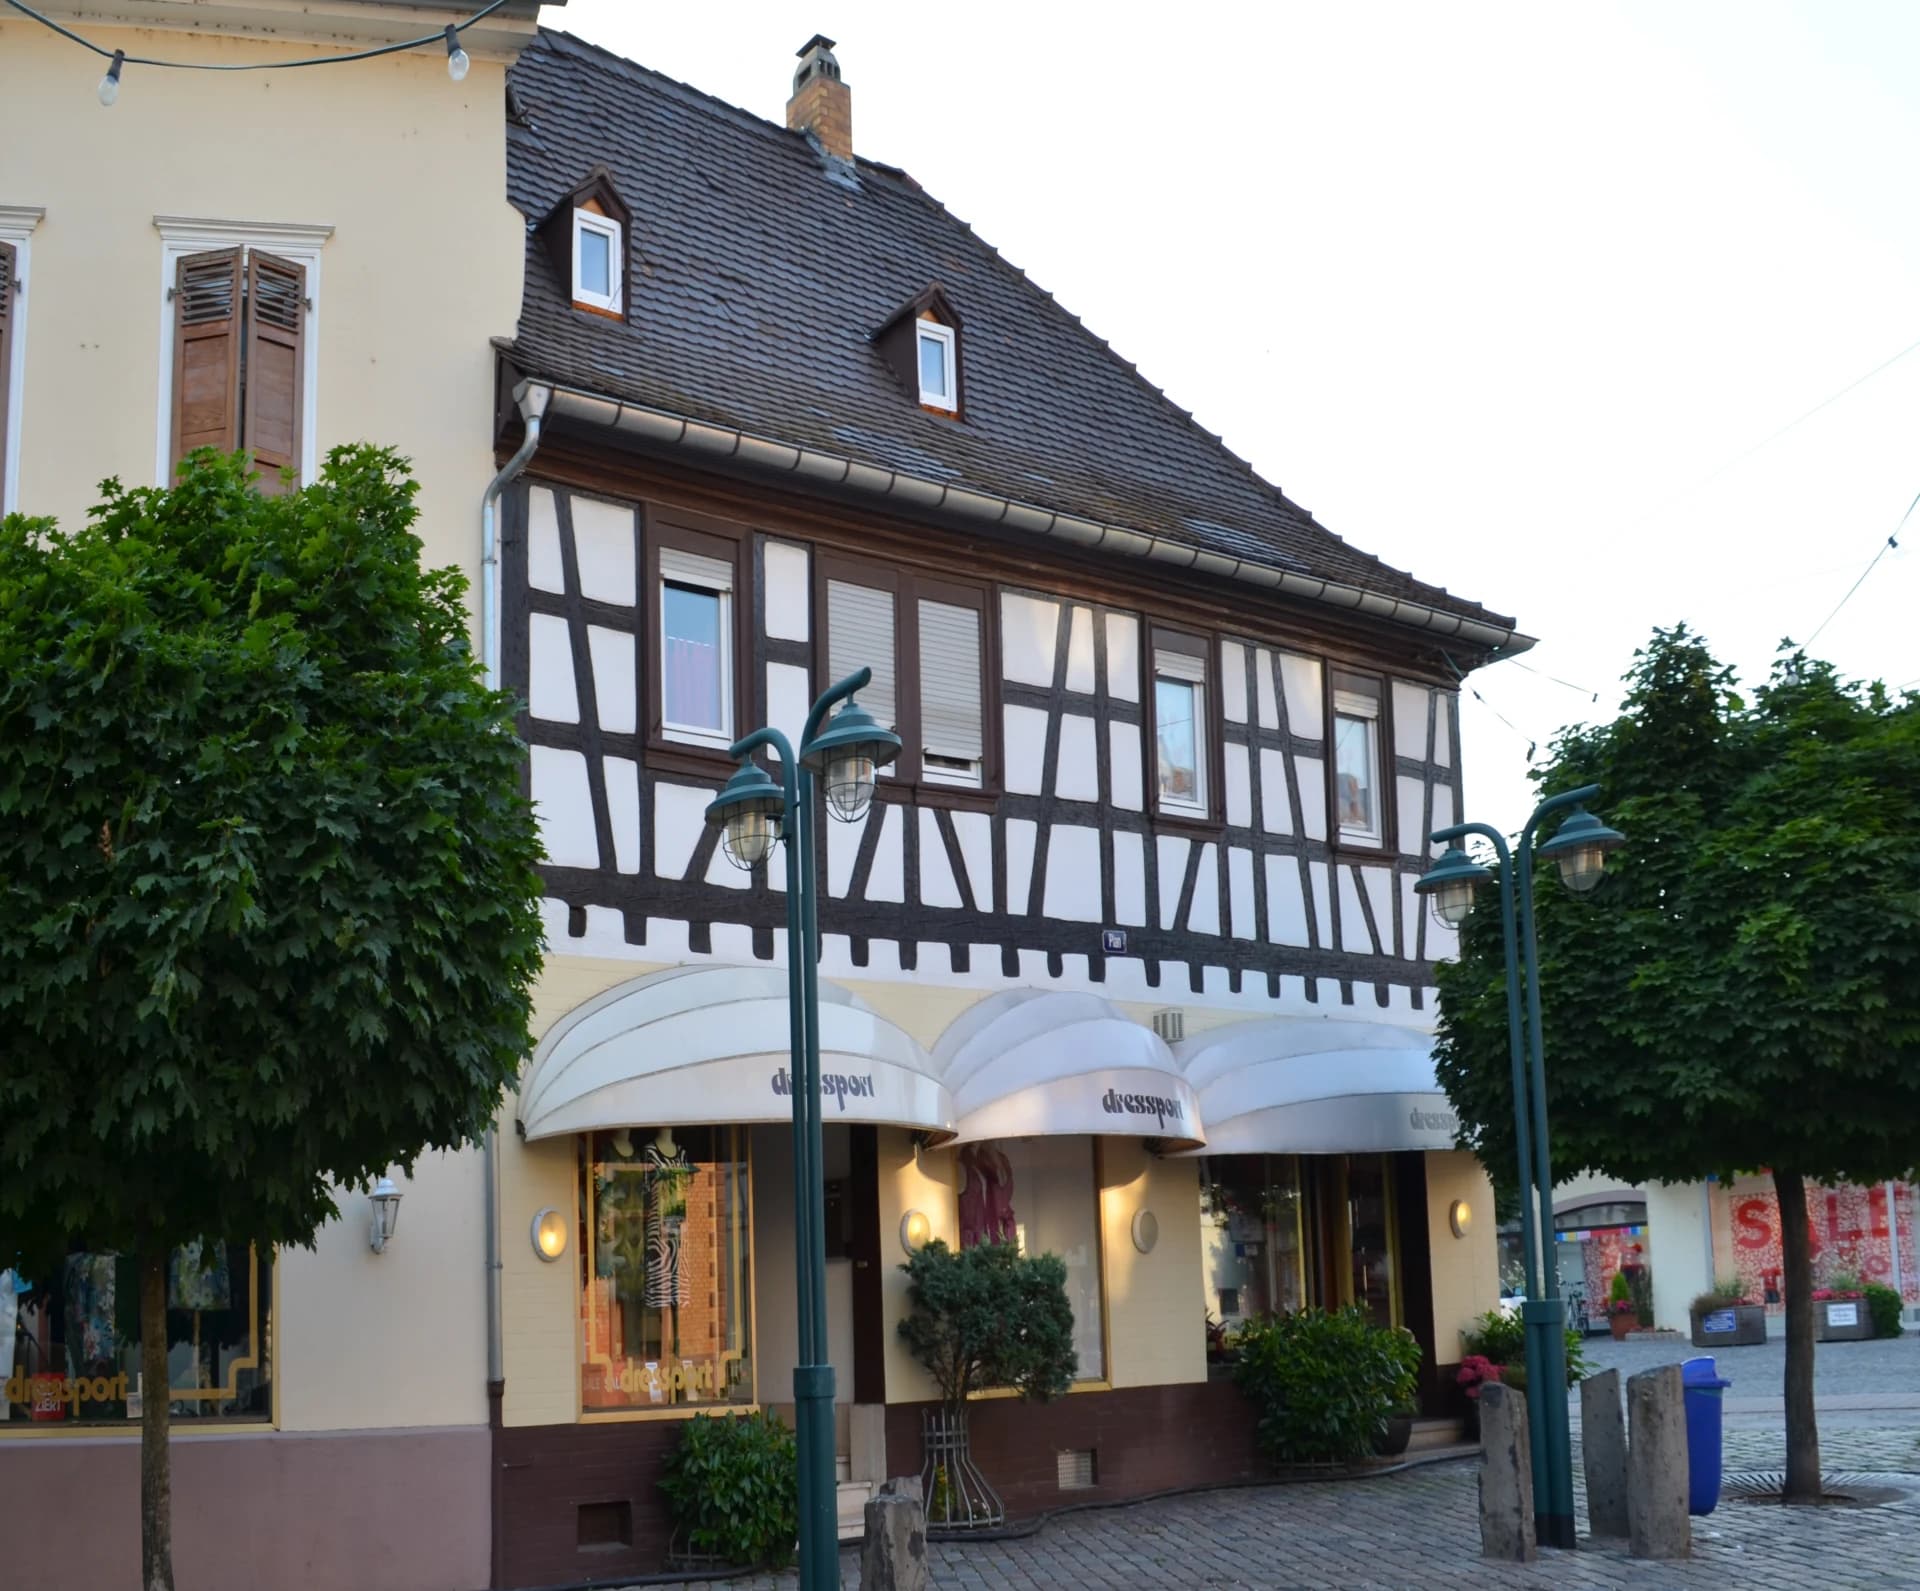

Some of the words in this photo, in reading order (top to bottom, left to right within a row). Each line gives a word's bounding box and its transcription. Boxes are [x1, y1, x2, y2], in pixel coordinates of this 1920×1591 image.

[1102, 1088, 1184, 1129] dressport
[1410, 1107, 1459, 1137] dressp
[1736, 1187, 1908, 1258] SLE
[5, 1364, 128, 1416] dressport
[619, 1356, 713, 1404] dressport
